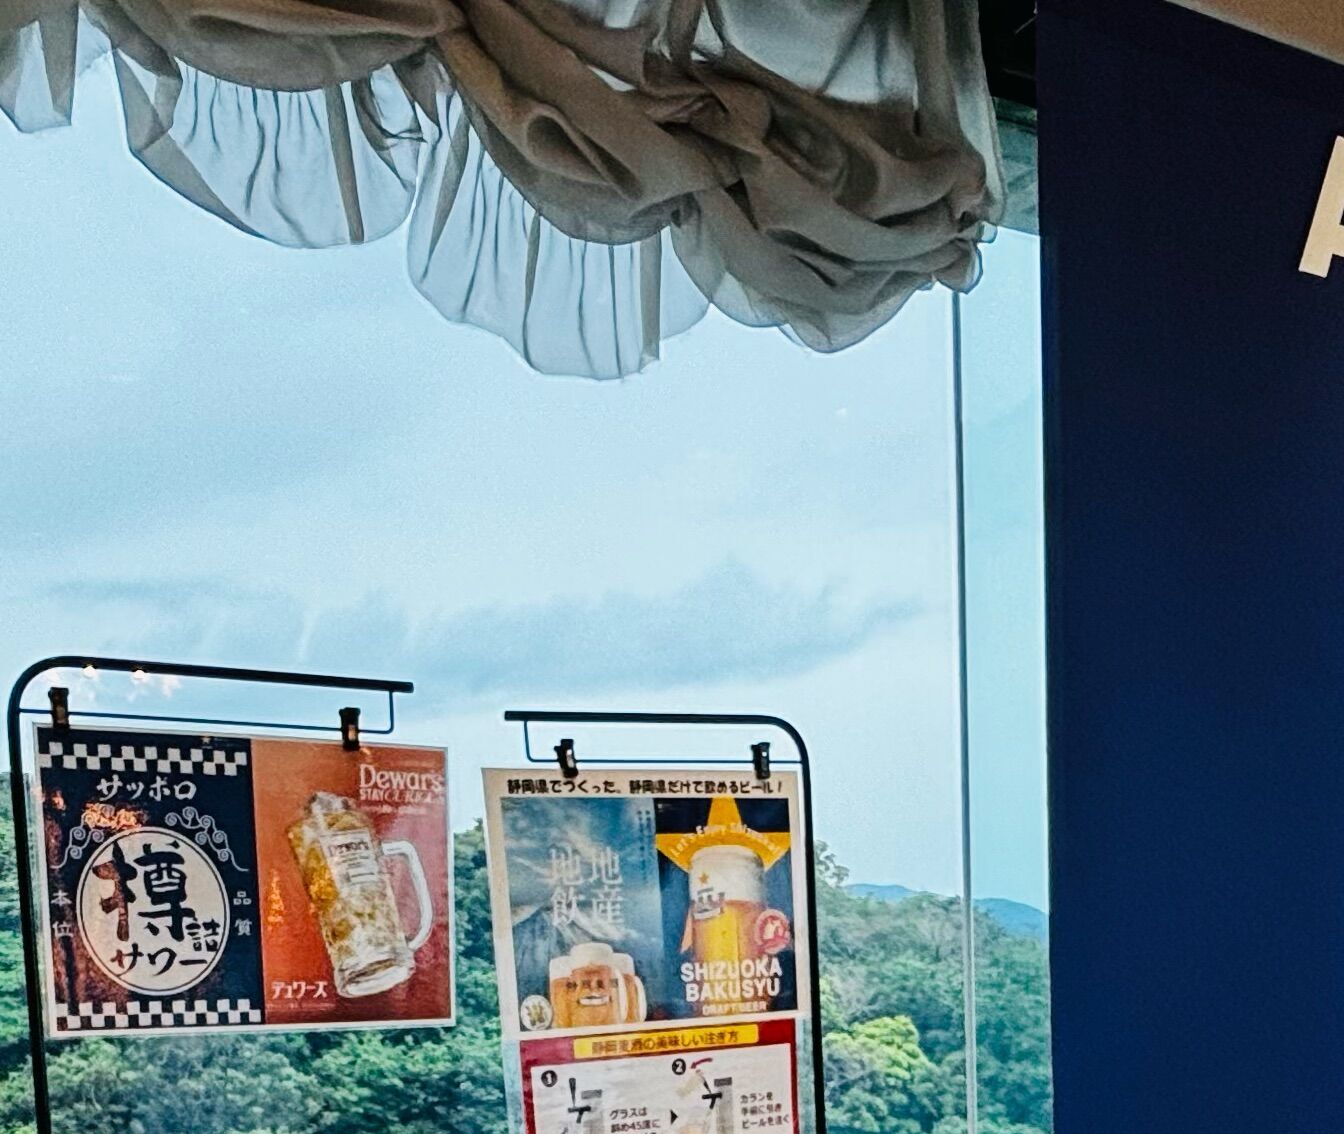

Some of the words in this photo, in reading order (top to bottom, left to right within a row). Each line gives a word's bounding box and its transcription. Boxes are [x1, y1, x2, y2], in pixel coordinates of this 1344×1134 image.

[96, 774, 197, 801] サッポロ
[51, 890, 74, 938] 本位
[233, 891, 252, 936] 品質
[110, 943, 208, 976] サワー
[680, 957, 782, 982] SHIZUOKA
[686, 978, 781, 1002] BAKUSYU
[609, 1107, 648, 1120] グラスは
